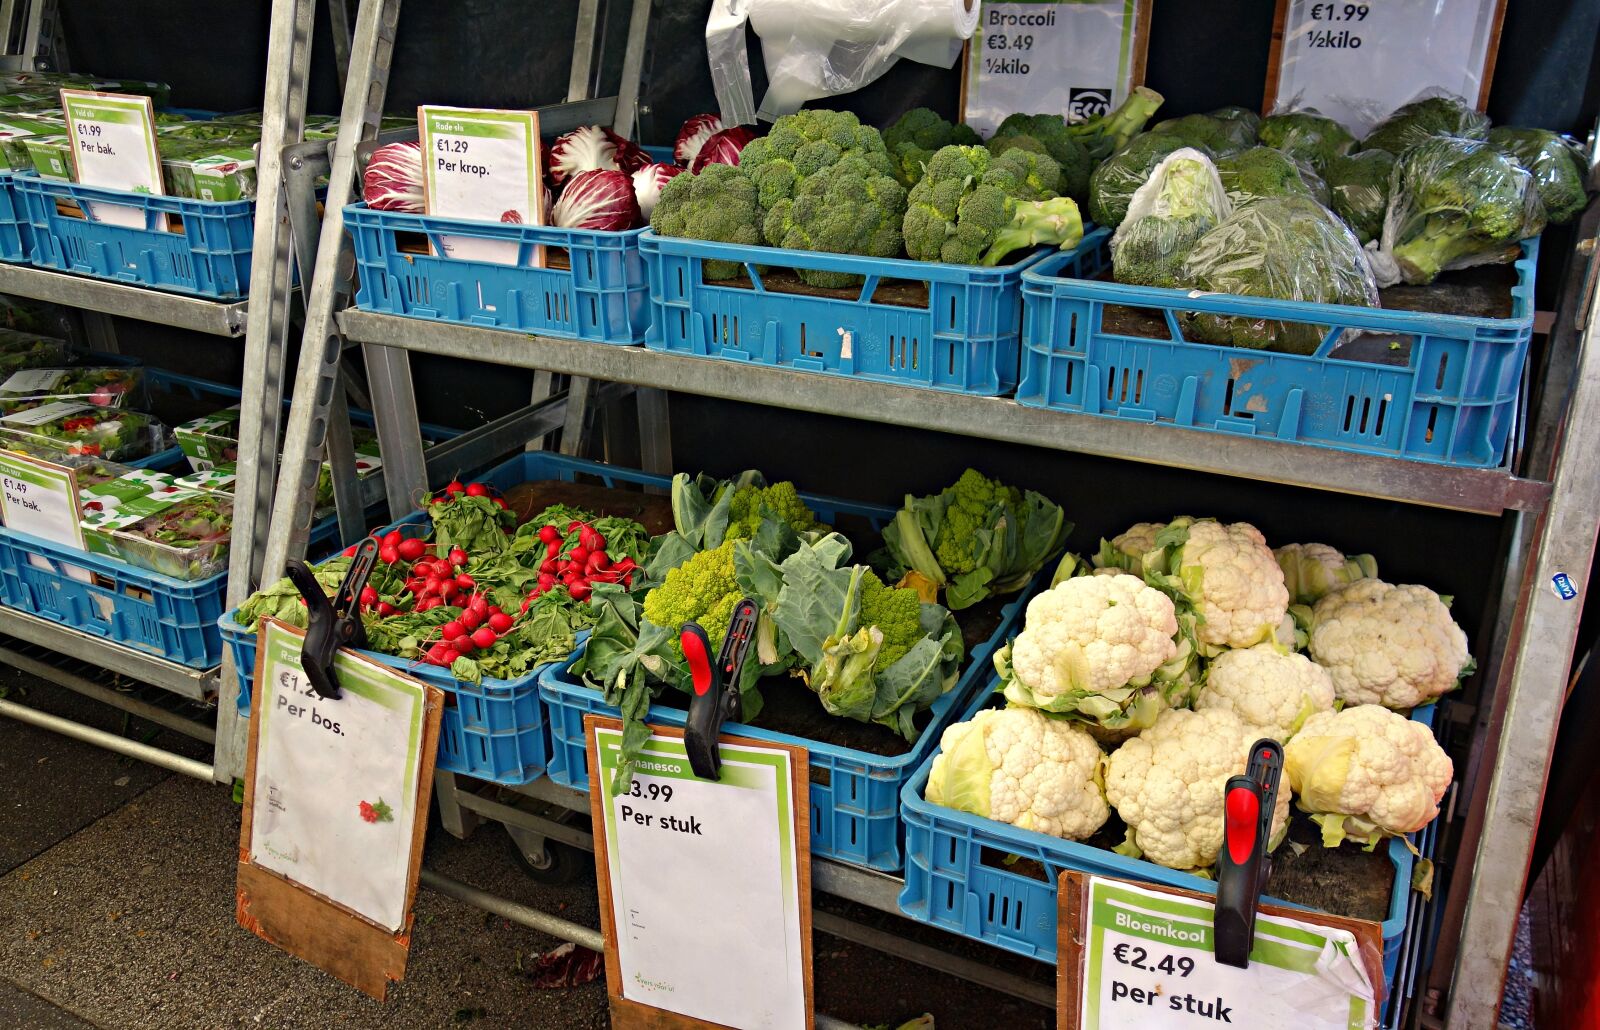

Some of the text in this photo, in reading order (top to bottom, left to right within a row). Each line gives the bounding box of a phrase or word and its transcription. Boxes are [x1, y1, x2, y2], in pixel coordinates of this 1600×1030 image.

[988, 10, 1056, 27] Broccoli
[1310, 3, 1369, 22] €1.99
[987, 34, 1034, 51] €3.49
[78, 123, 102, 136] €1.99
[435, 121, 464, 132] Rode sla
[81, 140, 116, 155] Per bak.
[437, 138, 469, 153] €1.29
[438, 158, 490, 178] Per krop.
[4, 478, 27, 493] €1.49
[6, 492, 41, 512] Per bak.
[280, 650, 302, 664] Rad
[279, 671, 325, 702] €1.2
[277, 694, 345, 737] Per bos.
[623, 779, 673, 803] 3.99
[621, 805, 702, 836] Per stuk
[1115, 912, 1206, 944] Bloemkool
[1112, 942, 1196, 978] €2.49
[1111, 979, 1233, 1024] per stuk
